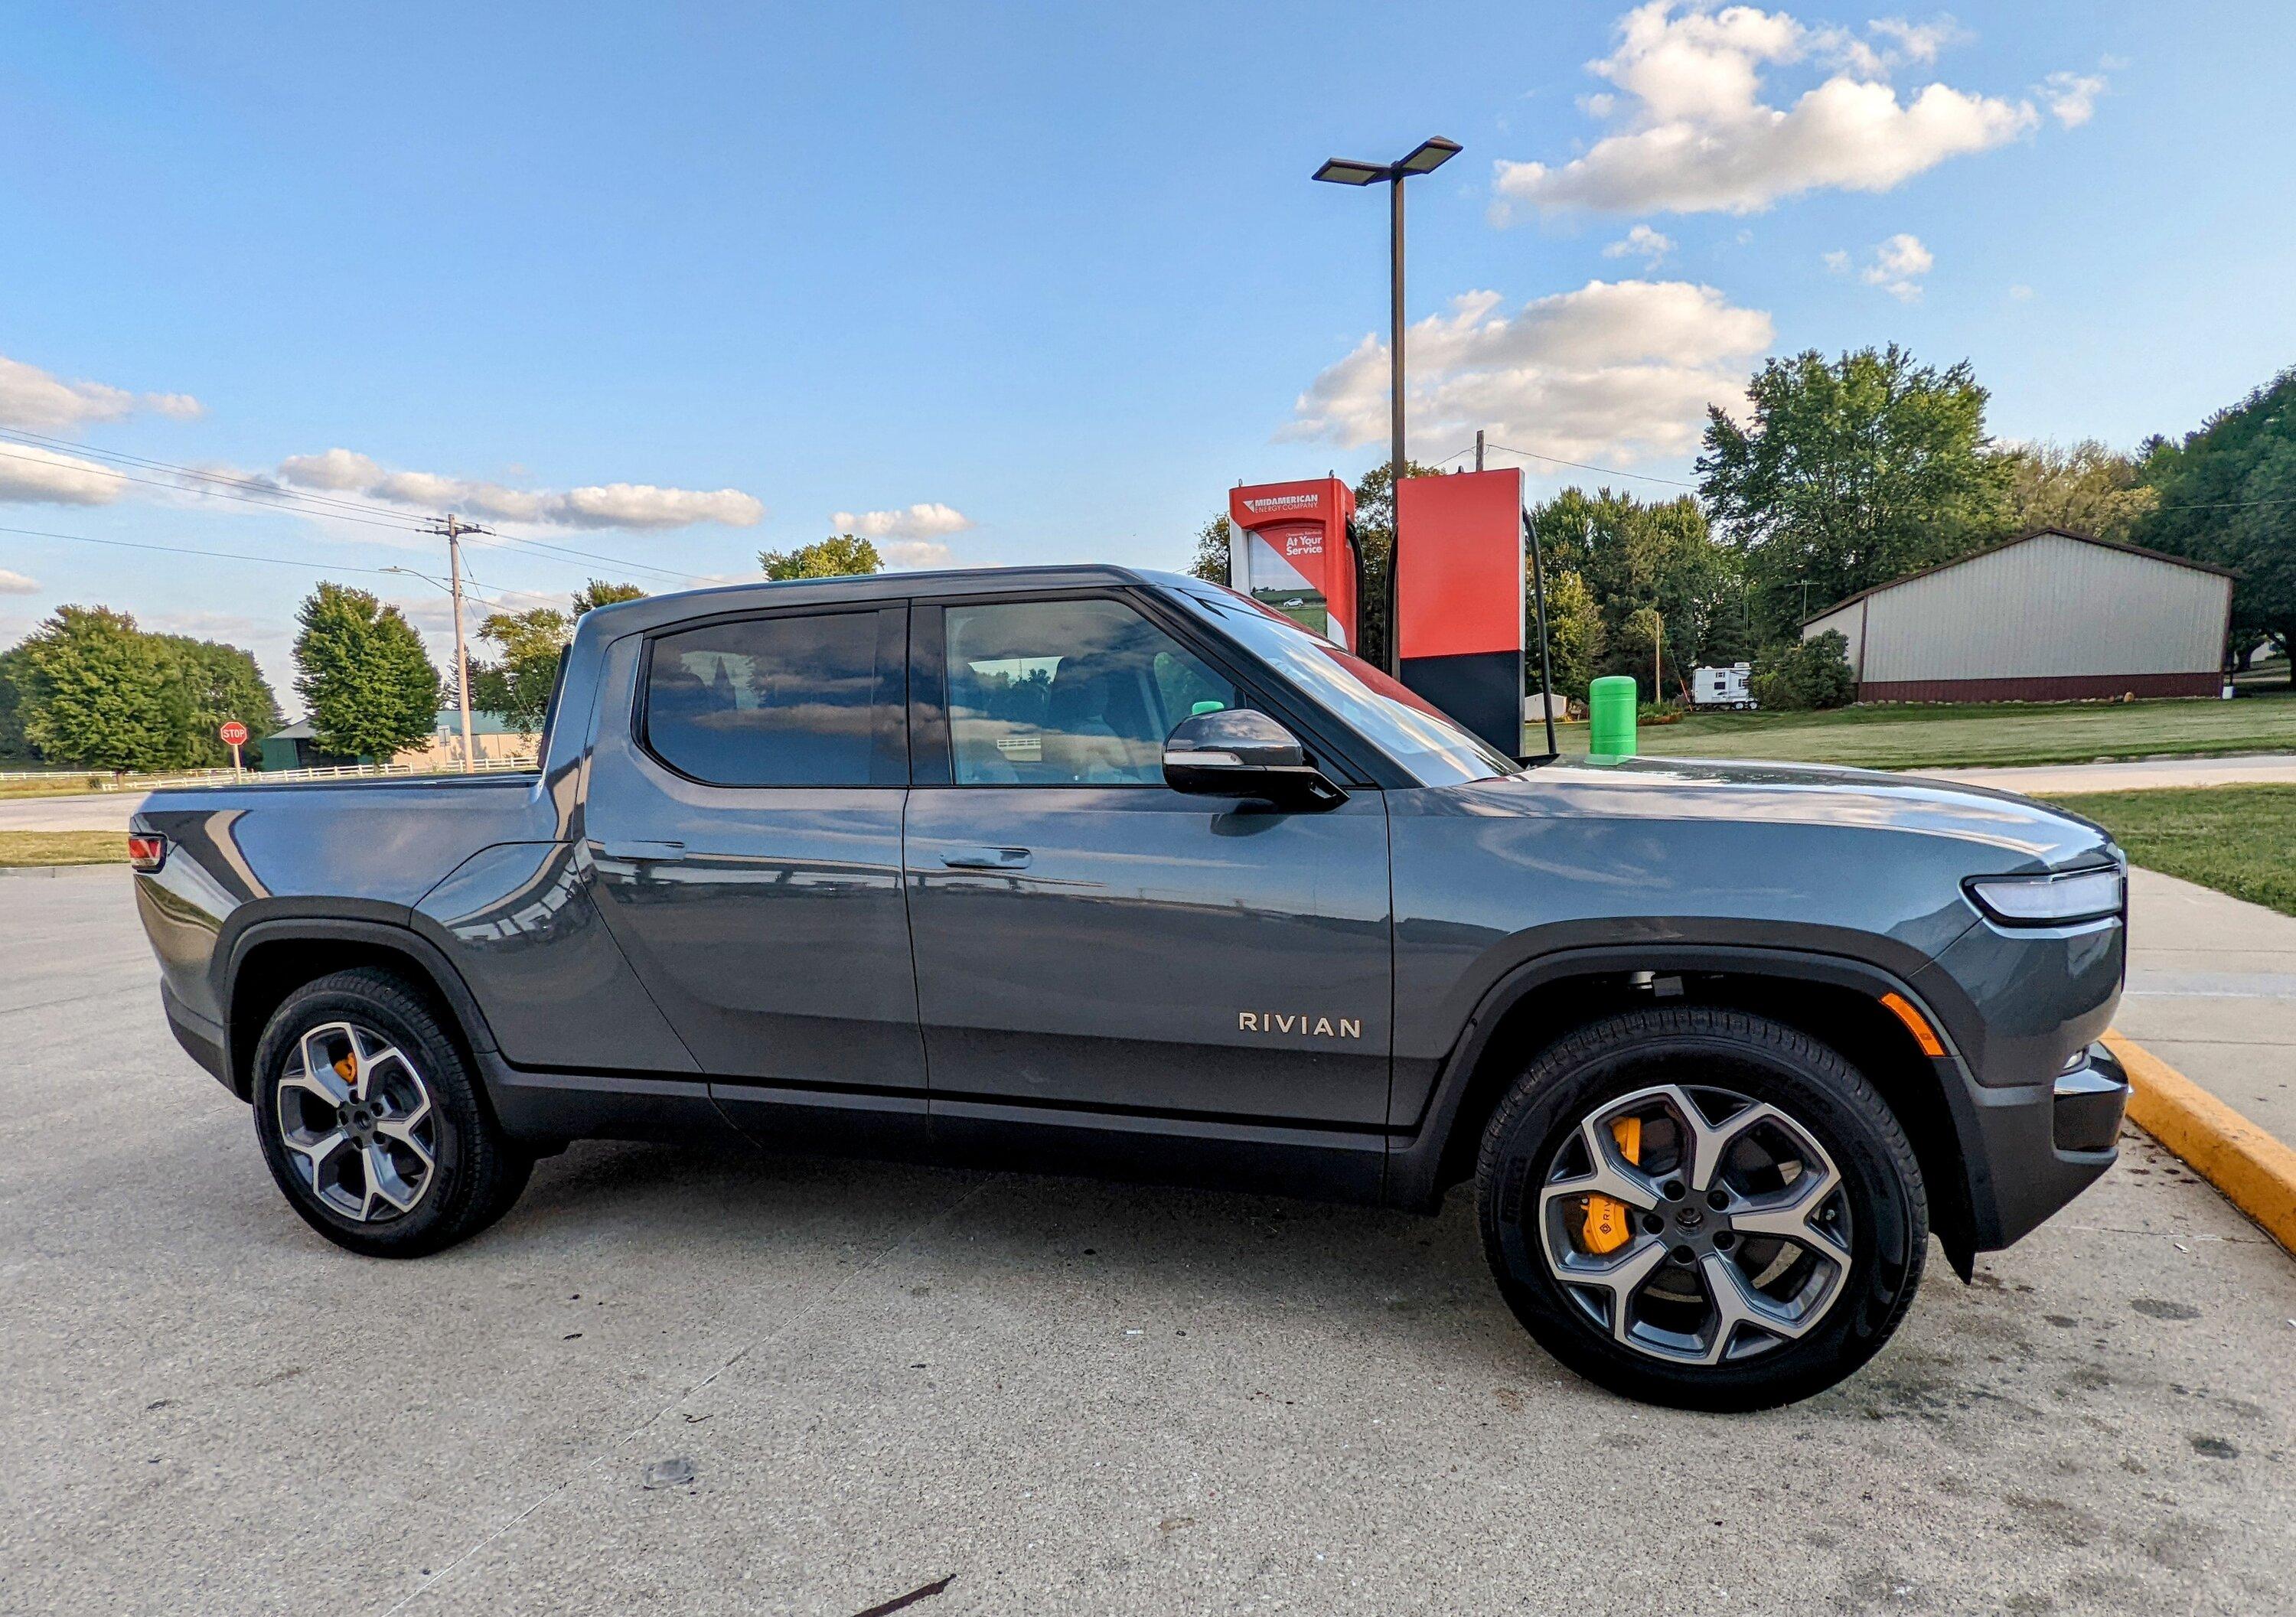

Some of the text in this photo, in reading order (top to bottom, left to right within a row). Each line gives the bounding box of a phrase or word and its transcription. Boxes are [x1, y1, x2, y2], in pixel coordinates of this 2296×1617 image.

[1255, 494, 1318, 506] MIDAMERICAN
[1287, 536, 1322, 546] At Your
[1287, 544, 1322, 556] Service
[223, 729, 244, 738] STOP
[1238, 1012, 1361, 1038] RIVIAN
